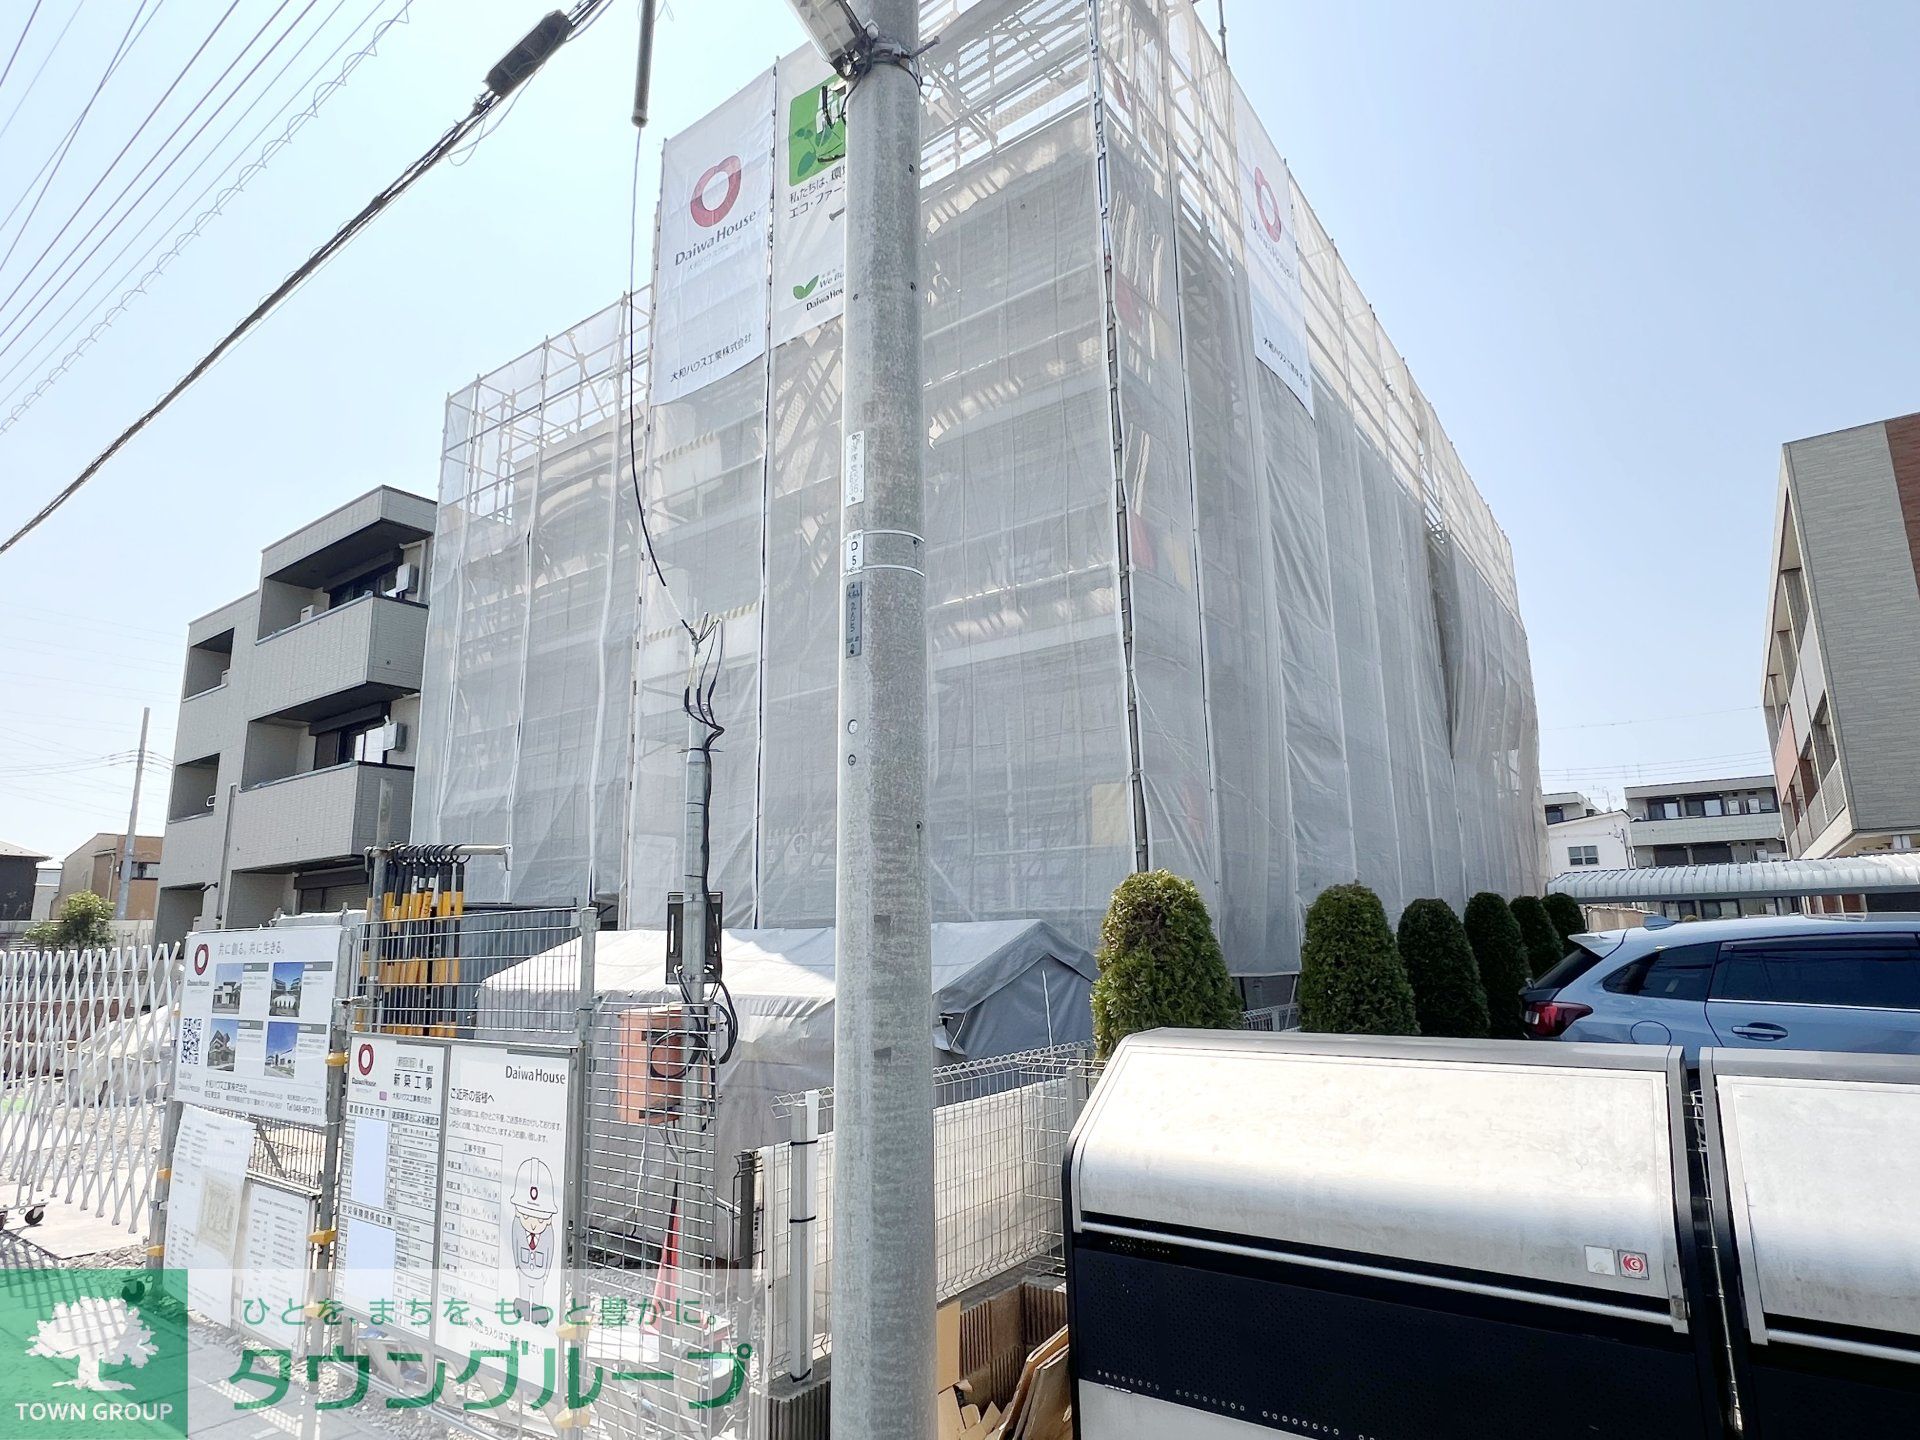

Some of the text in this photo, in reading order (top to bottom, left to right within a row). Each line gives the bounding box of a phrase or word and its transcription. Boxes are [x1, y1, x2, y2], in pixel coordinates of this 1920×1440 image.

[675, 236, 714, 266] Daiwa
[716, 210, 756, 242] House
[505, 1065, 566, 1084] Daiwa House
[450, 1087, 495, 1104] ご近所の皆様へ
